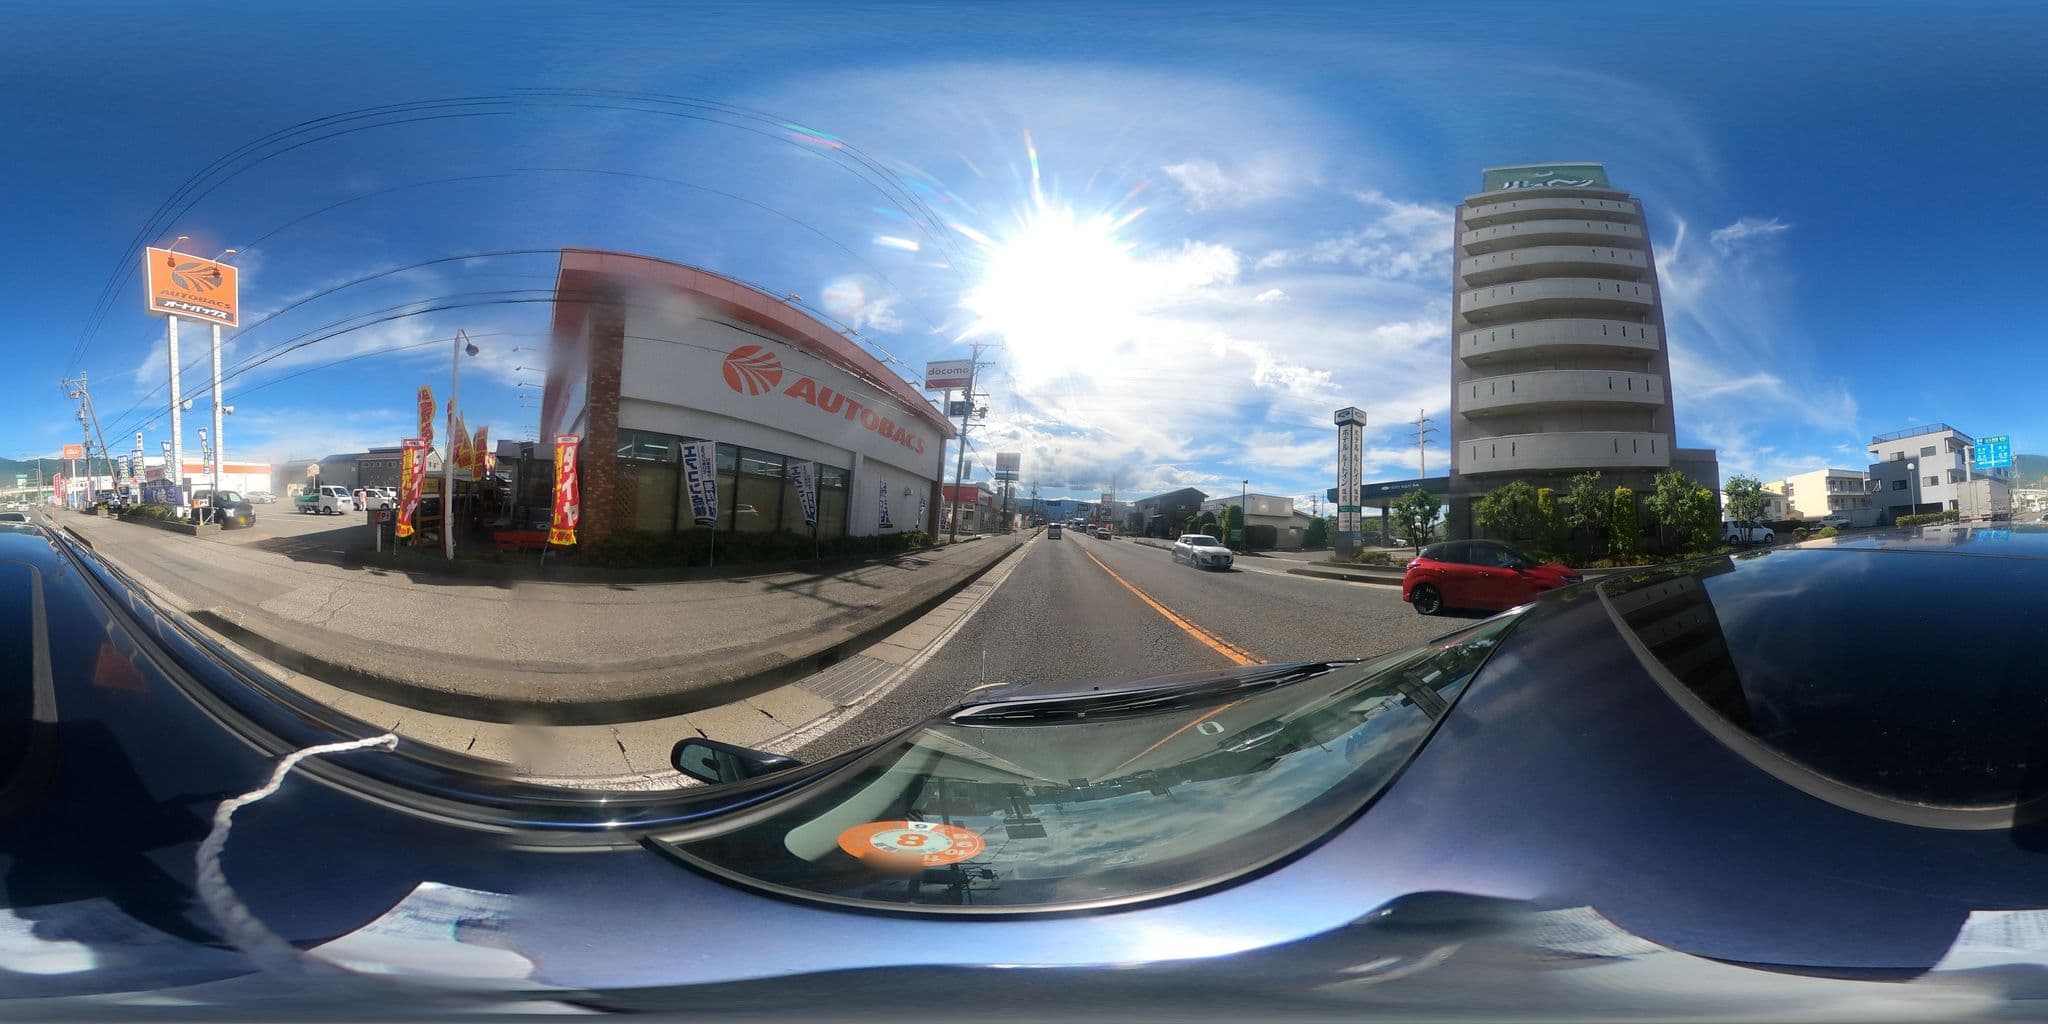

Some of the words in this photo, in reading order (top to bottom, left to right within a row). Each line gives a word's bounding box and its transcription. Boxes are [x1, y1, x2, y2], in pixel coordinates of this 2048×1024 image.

[160, 289, 232, 309] AUTOBACS
[163, 300, 228, 319] オートバックス
[928, 367, 969, 376] docomo
[783, 377, 926, 455] AUTOBACS
[1341, 429, 1350, 451] ホテル
[562, 445, 579, 527] タイヤ
[897, 833, 928, 847] 8
